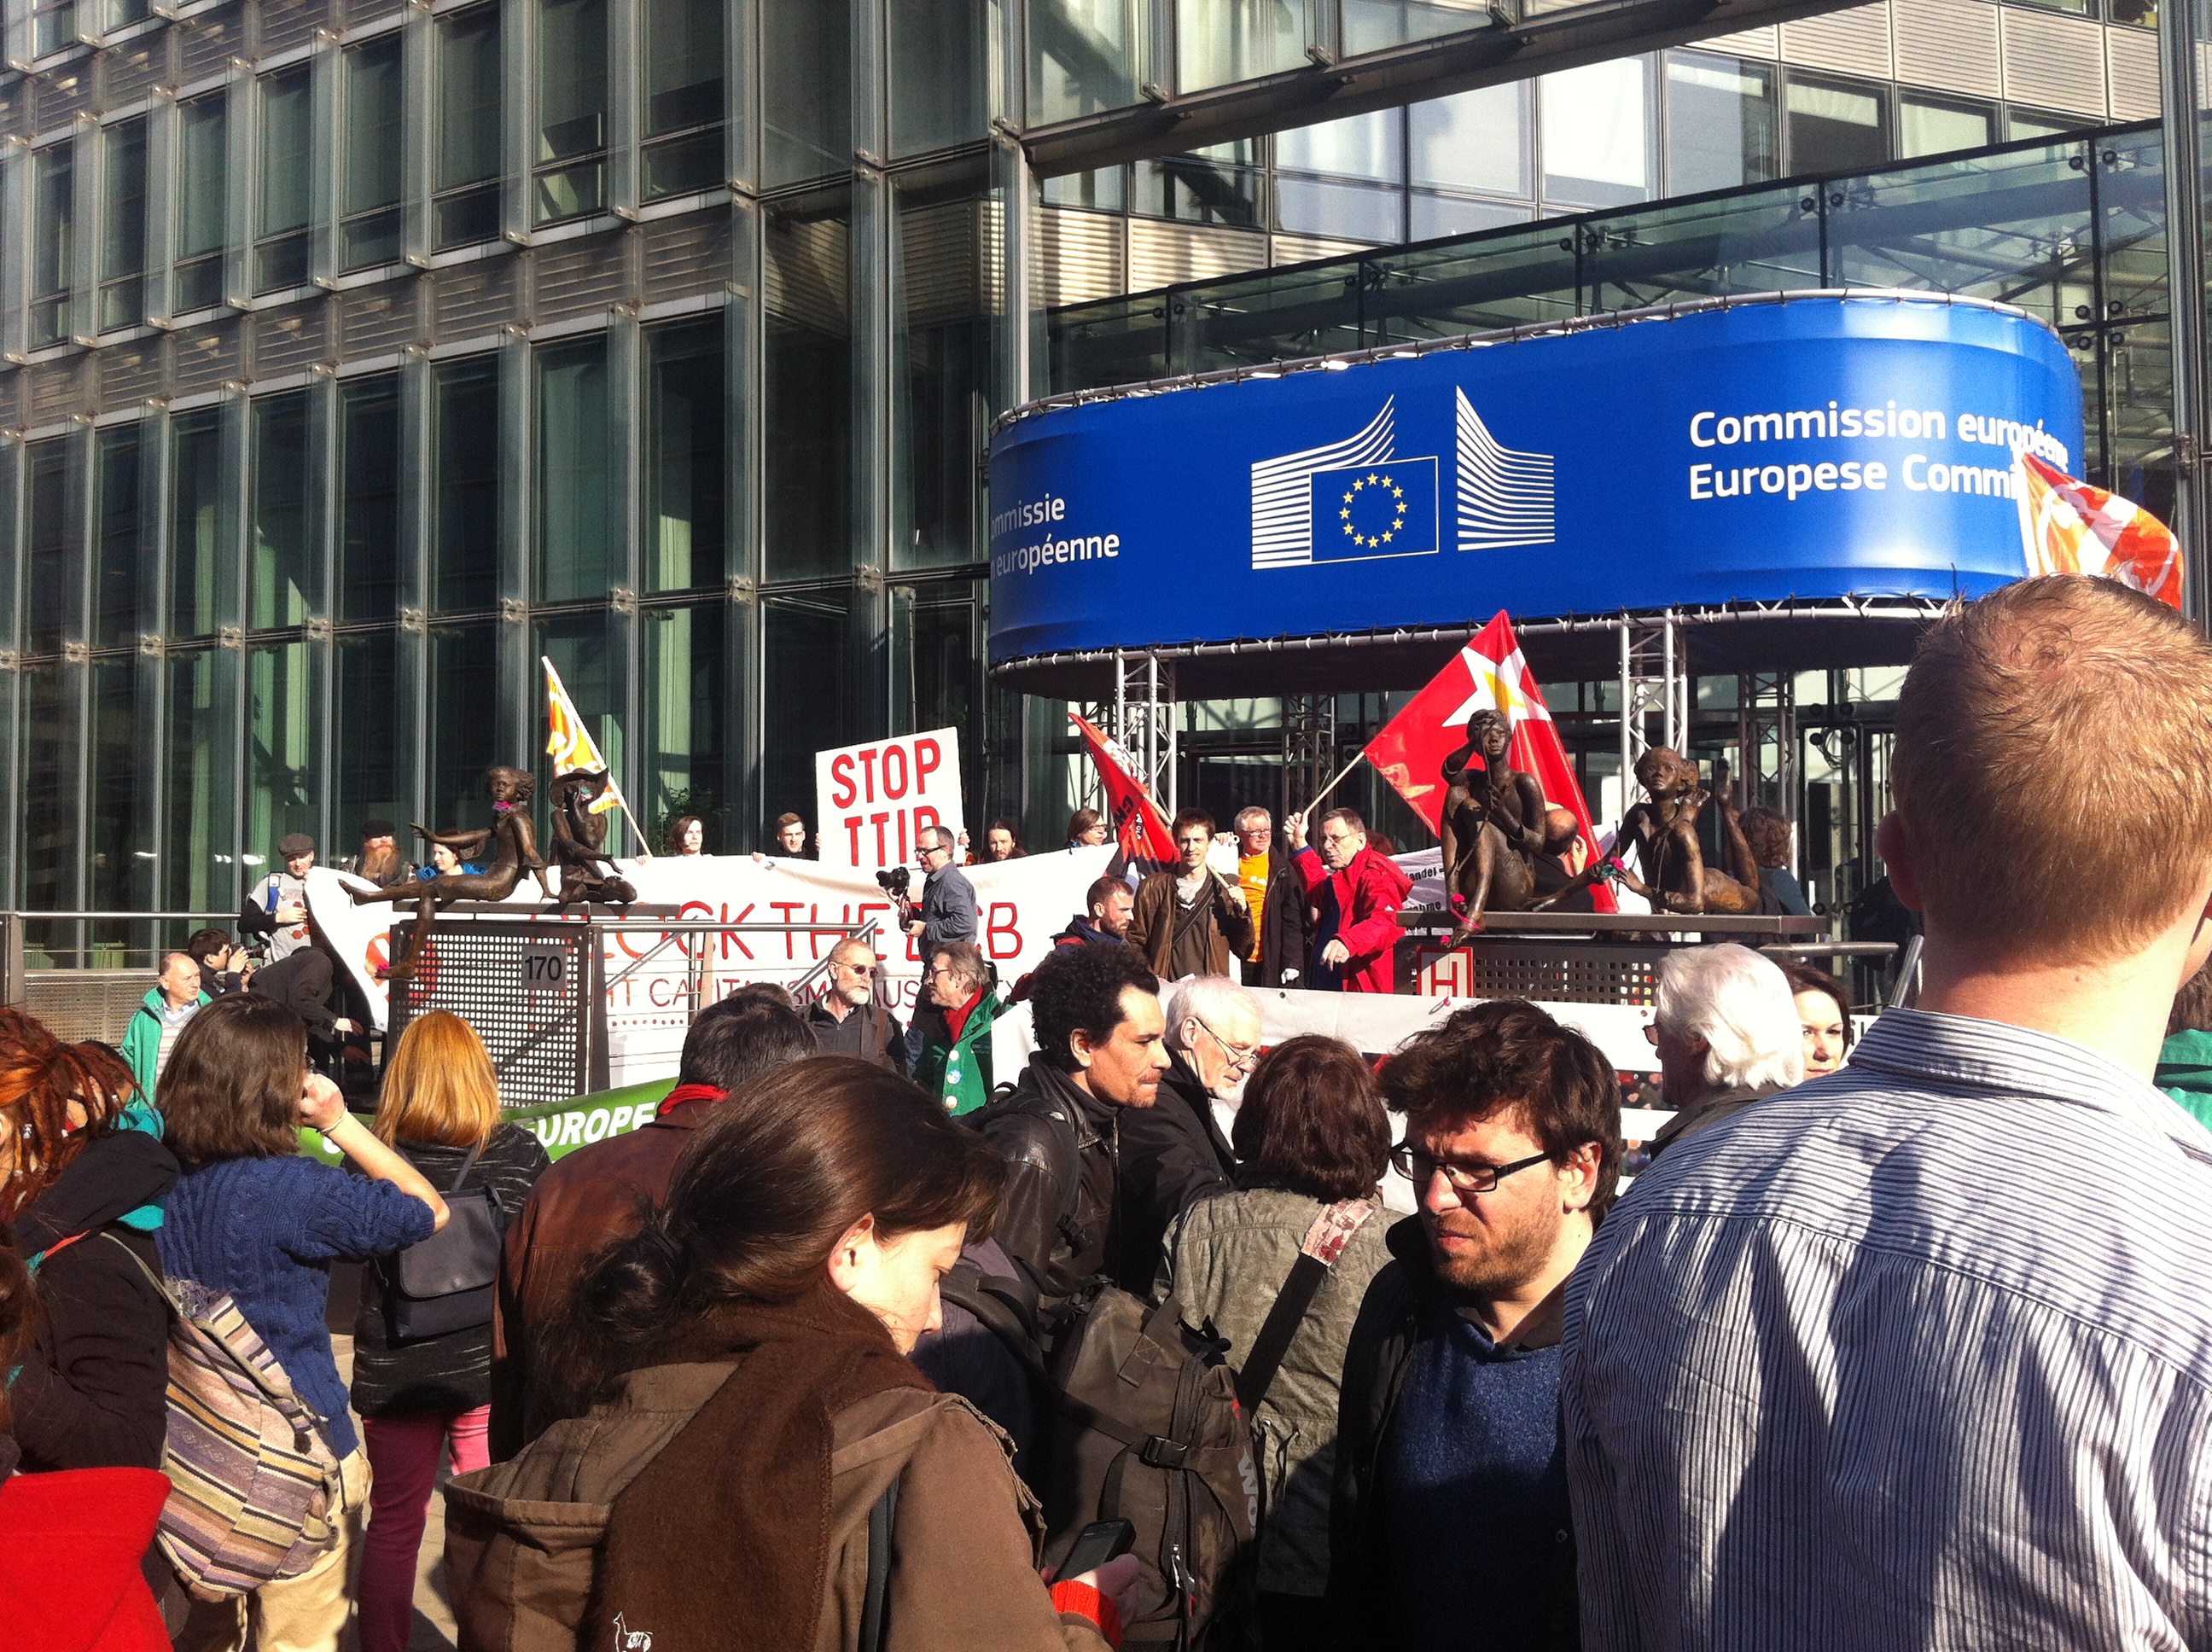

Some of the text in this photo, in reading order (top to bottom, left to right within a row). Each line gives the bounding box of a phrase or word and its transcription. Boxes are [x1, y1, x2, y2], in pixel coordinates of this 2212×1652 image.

[1690, 400, 1946, 448] Commission
[1690, 454, 2017, 501] Europese Commi
[997, 532, 1120, 575] européenne
[831, 738, 941, 809] STOP
[524, 955, 562, 981] 170
